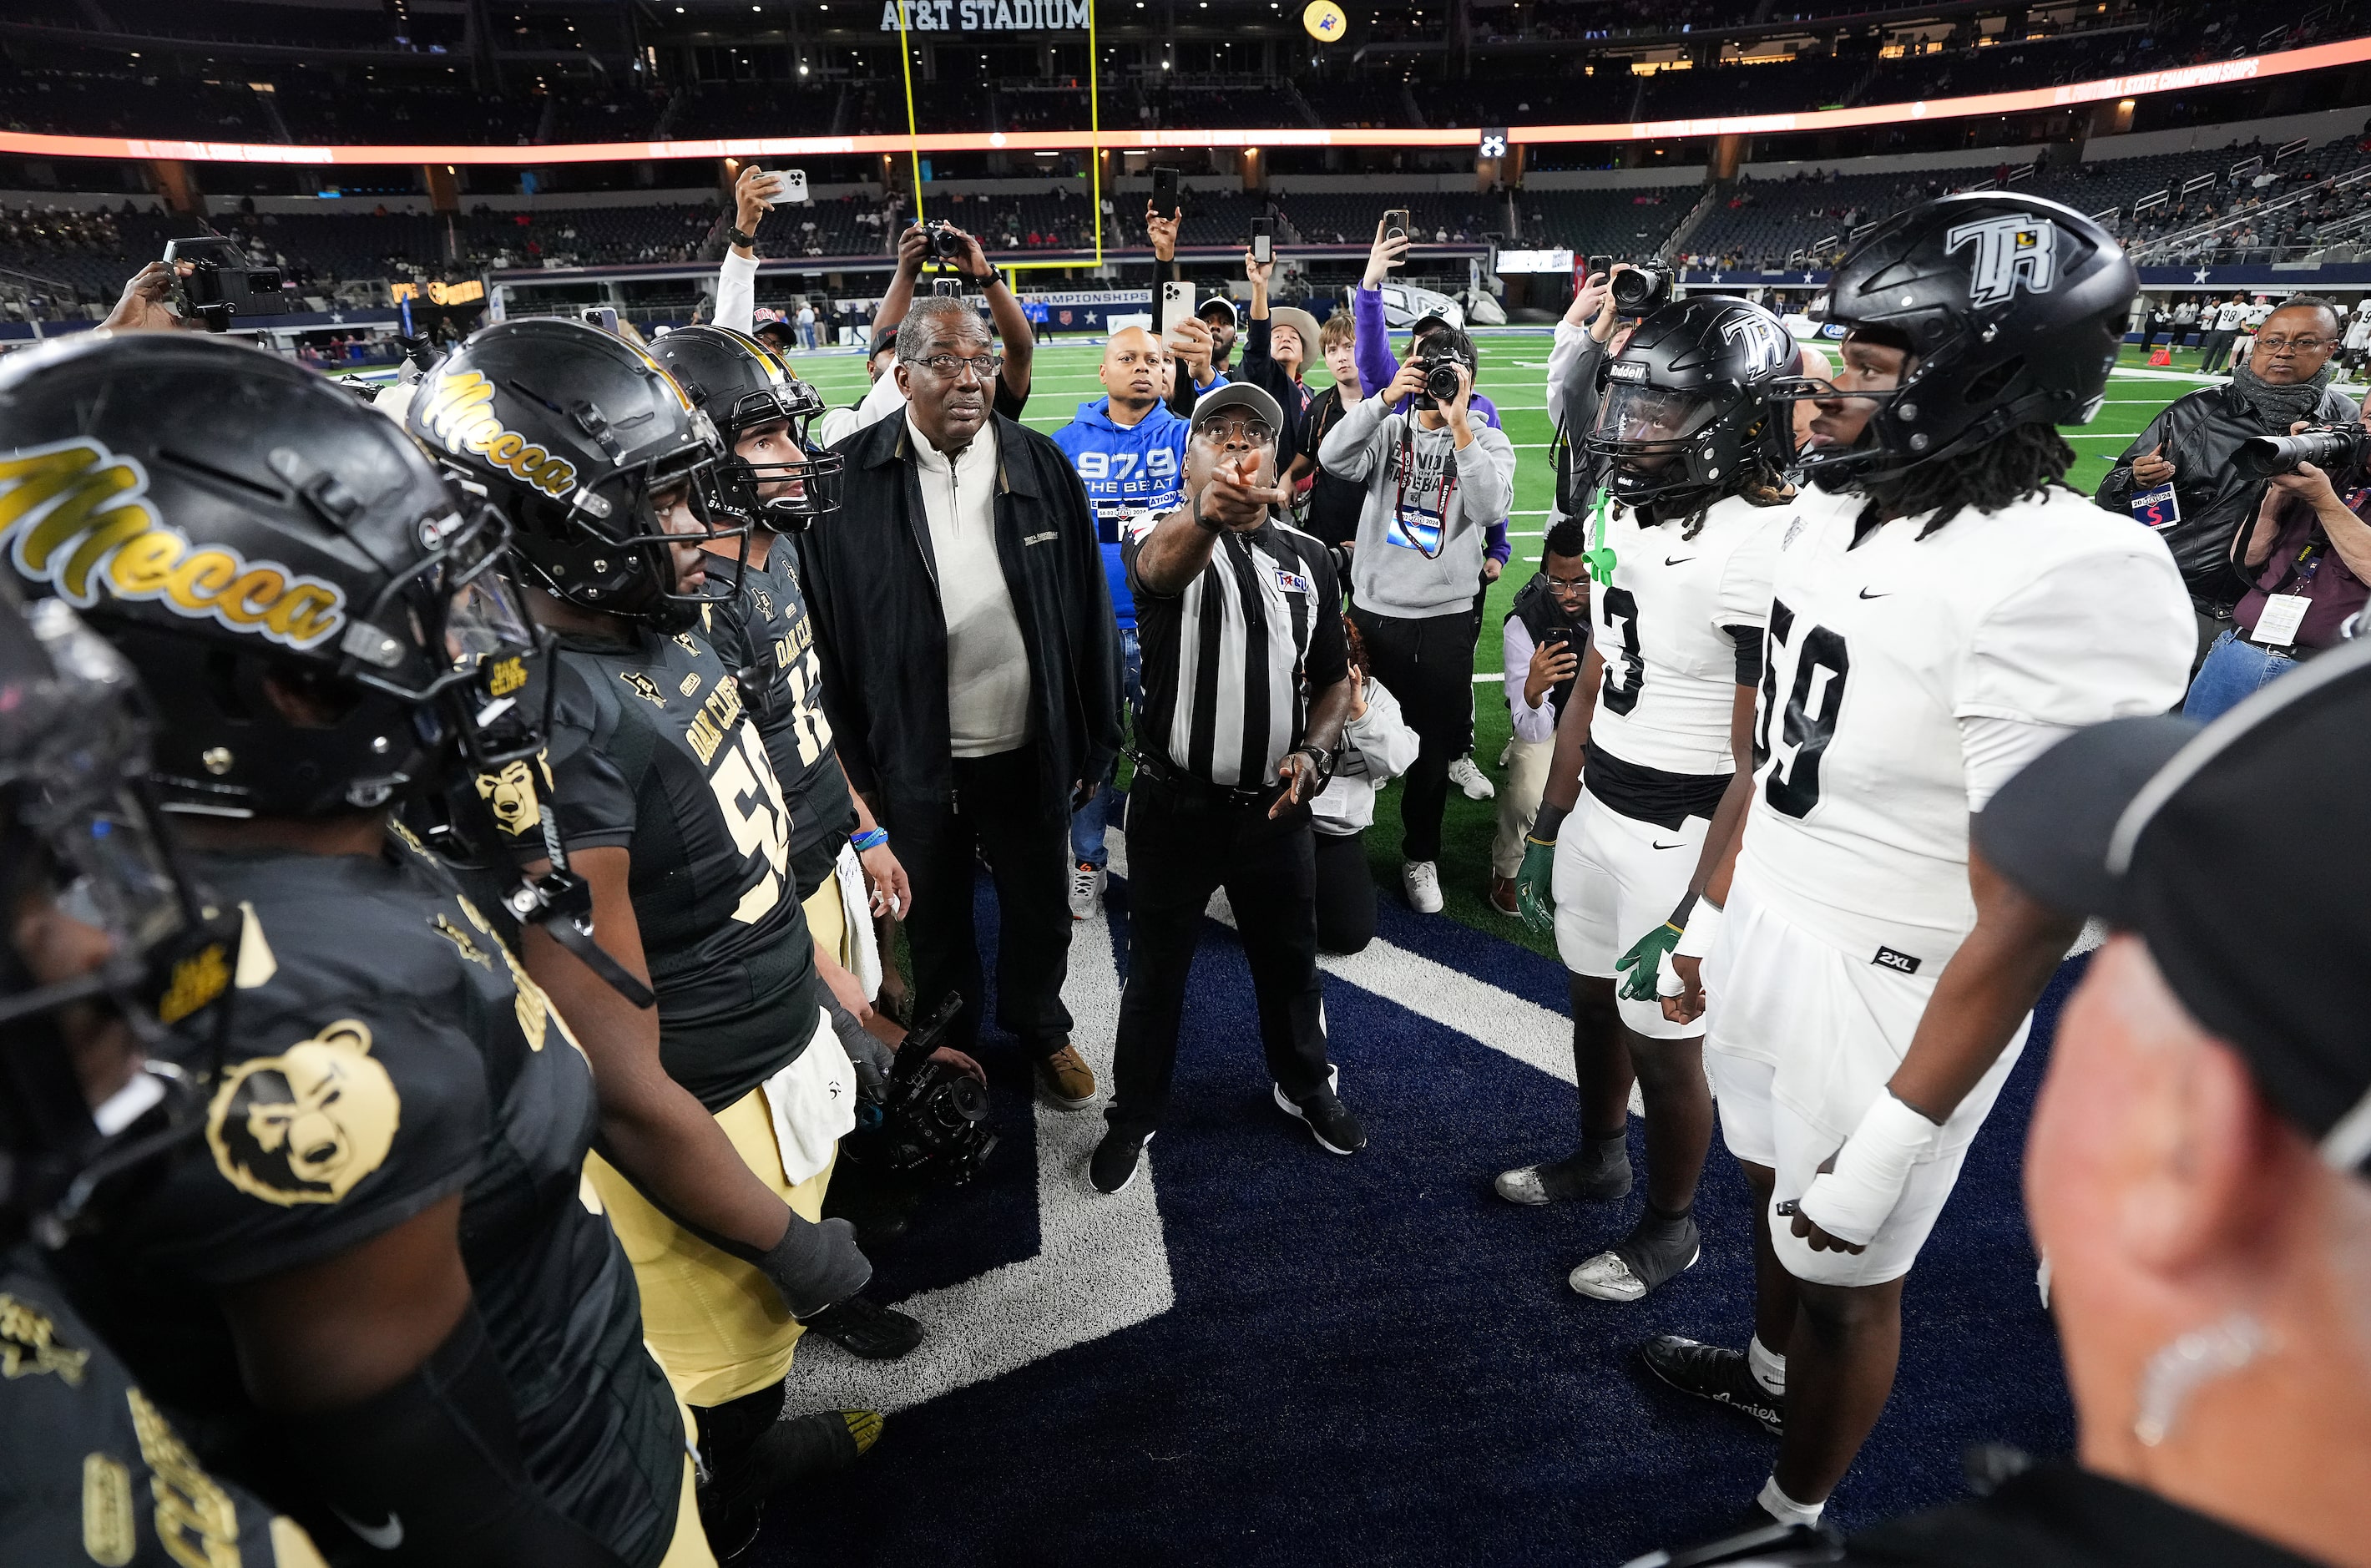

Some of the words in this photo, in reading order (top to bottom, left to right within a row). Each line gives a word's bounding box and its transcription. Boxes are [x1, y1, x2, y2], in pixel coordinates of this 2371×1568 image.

[880, 0, 953, 30] AT&T
[960, 0, 1091, 30] STADIUM
[2124, 73, 2160, 94] STATE
[2158, 58, 2260, 90] CHAMPIONSHIPS
[1030, 292, 1149, 306] HAMPIONSHIPS
[2223, 310, 2237, 323] 98
[1609, 364, 1646, 379] Riddell
[2150, 352, 2166, 364] 20
[422, 371, 576, 497] Mecca
[1077, 446, 1177, 480] 97.9
[1124, 476, 1175, 493] BEAT
[1438, 484, 1450, 514] Canon
[2146, 506, 2163, 526] S
[0, 445, 344, 645] Mecca
[2298, 545, 2313, 563] Nikon
[775, 629, 800, 669] OAK
[1603, 586, 1645, 717] 3
[685, 709, 724, 766] OAK
[1878, 951, 1911, 971] 2XL
